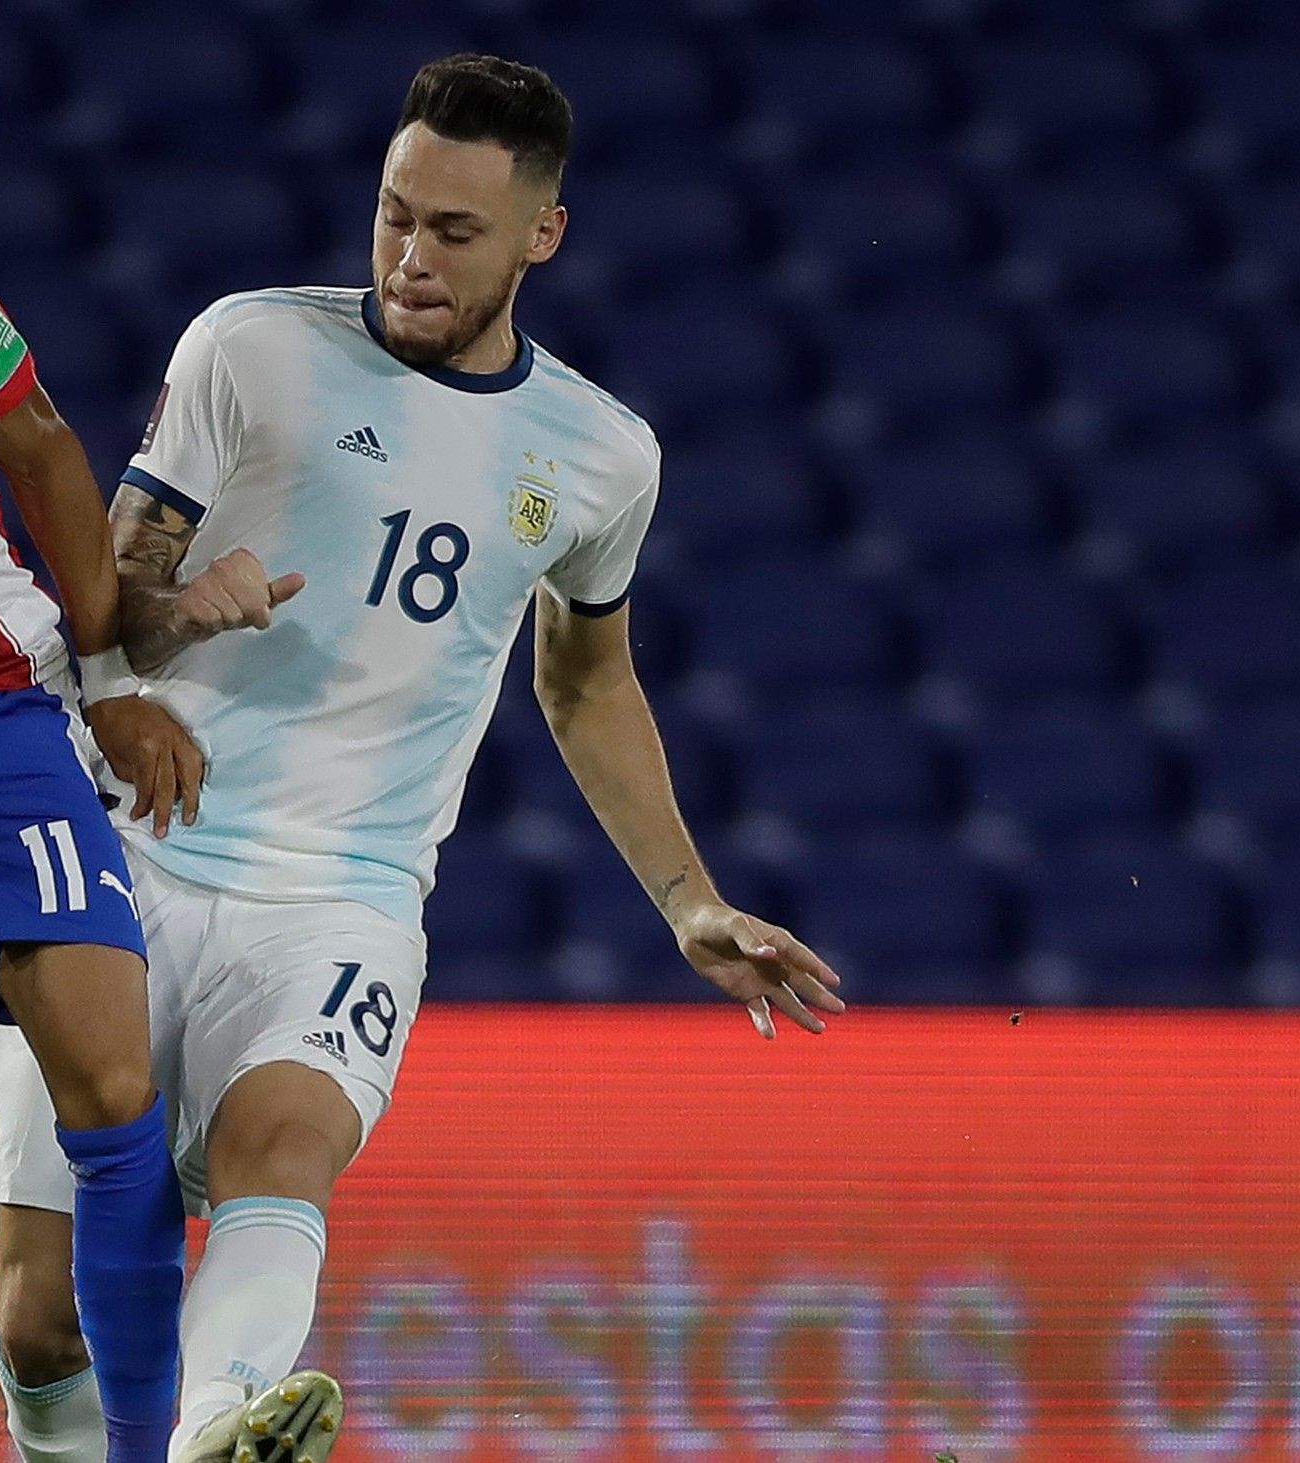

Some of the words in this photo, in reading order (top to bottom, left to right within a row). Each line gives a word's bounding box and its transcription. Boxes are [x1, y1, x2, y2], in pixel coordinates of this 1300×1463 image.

[336, 439, 388, 463] adidas
[519, 492, 547, 529] AFA
[364, 508, 470, 624] 18
[19, 819, 87, 914] 11
[318, 961, 397, 1057] 18
[302, 1035, 349, 1068] adidas
